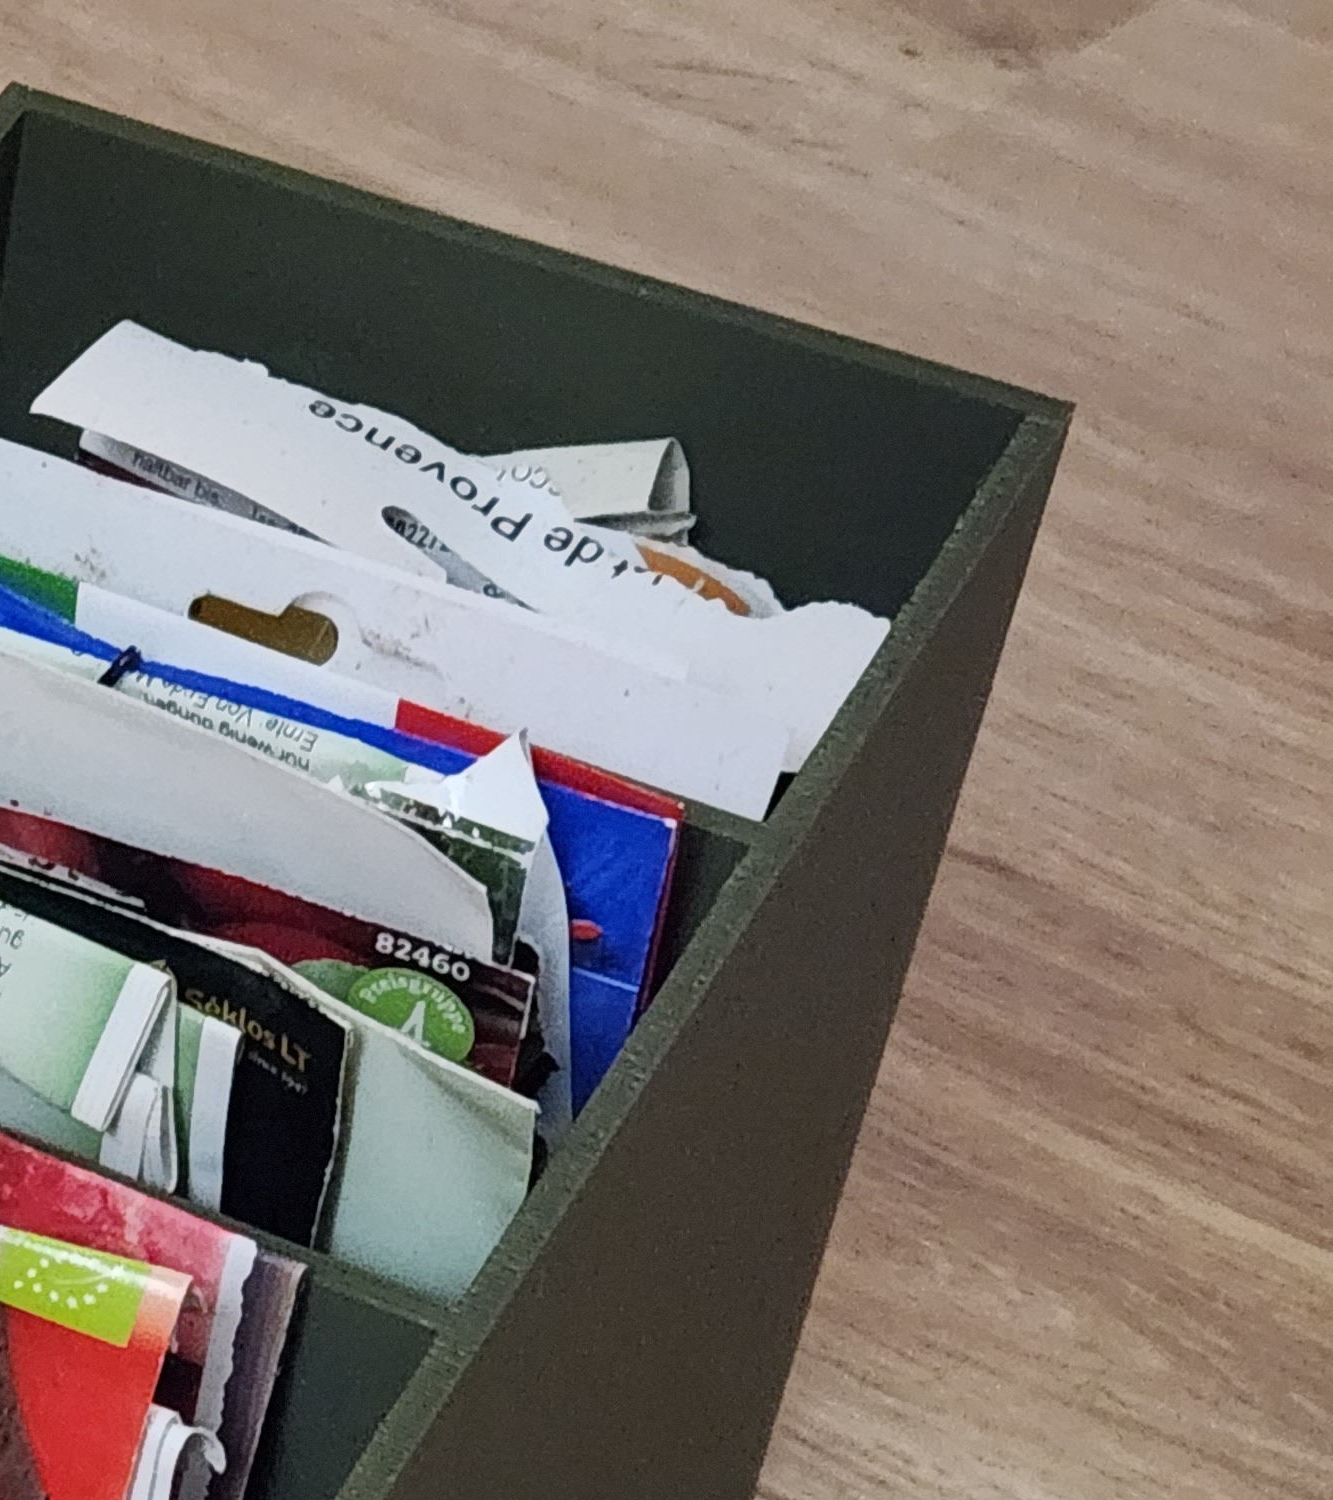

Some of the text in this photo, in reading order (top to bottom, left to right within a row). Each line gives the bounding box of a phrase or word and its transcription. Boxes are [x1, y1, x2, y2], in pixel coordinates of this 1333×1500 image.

[305, 394, 534, 544] Provence
[539, 520, 606, 578] de
[373, 930, 472, 982] 82460
